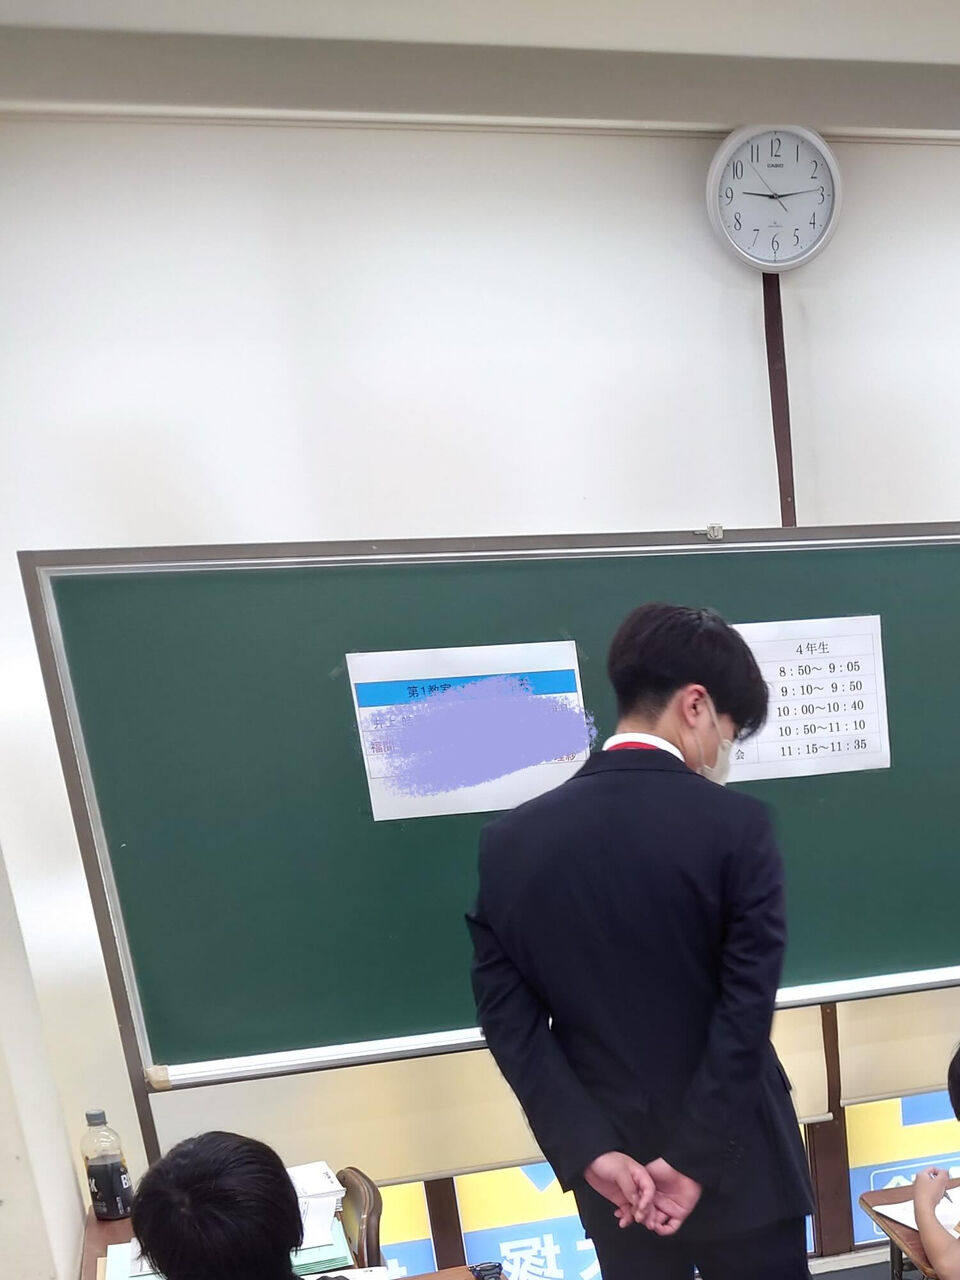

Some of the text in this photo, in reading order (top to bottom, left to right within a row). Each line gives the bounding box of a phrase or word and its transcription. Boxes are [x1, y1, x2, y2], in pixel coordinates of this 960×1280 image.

[751, 144, 759, 162] 11
[770, 138, 781, 157] 12
[796, 145, 799, 162] 1
[733, 160, 743, 180] 10
[811, 161, 818, 179] 2
[726, 187, 733, 205] 9
[818, 187, 824, 204] 3
[734, 212, 741, 231] 8
[810, 212, 816, 229] 4
[752, 229, 759, 246] 7
[772, 234, 779, 251] 6
[794, 229, 799, 246] 5
[796, 642, 830, 654] 4年生
